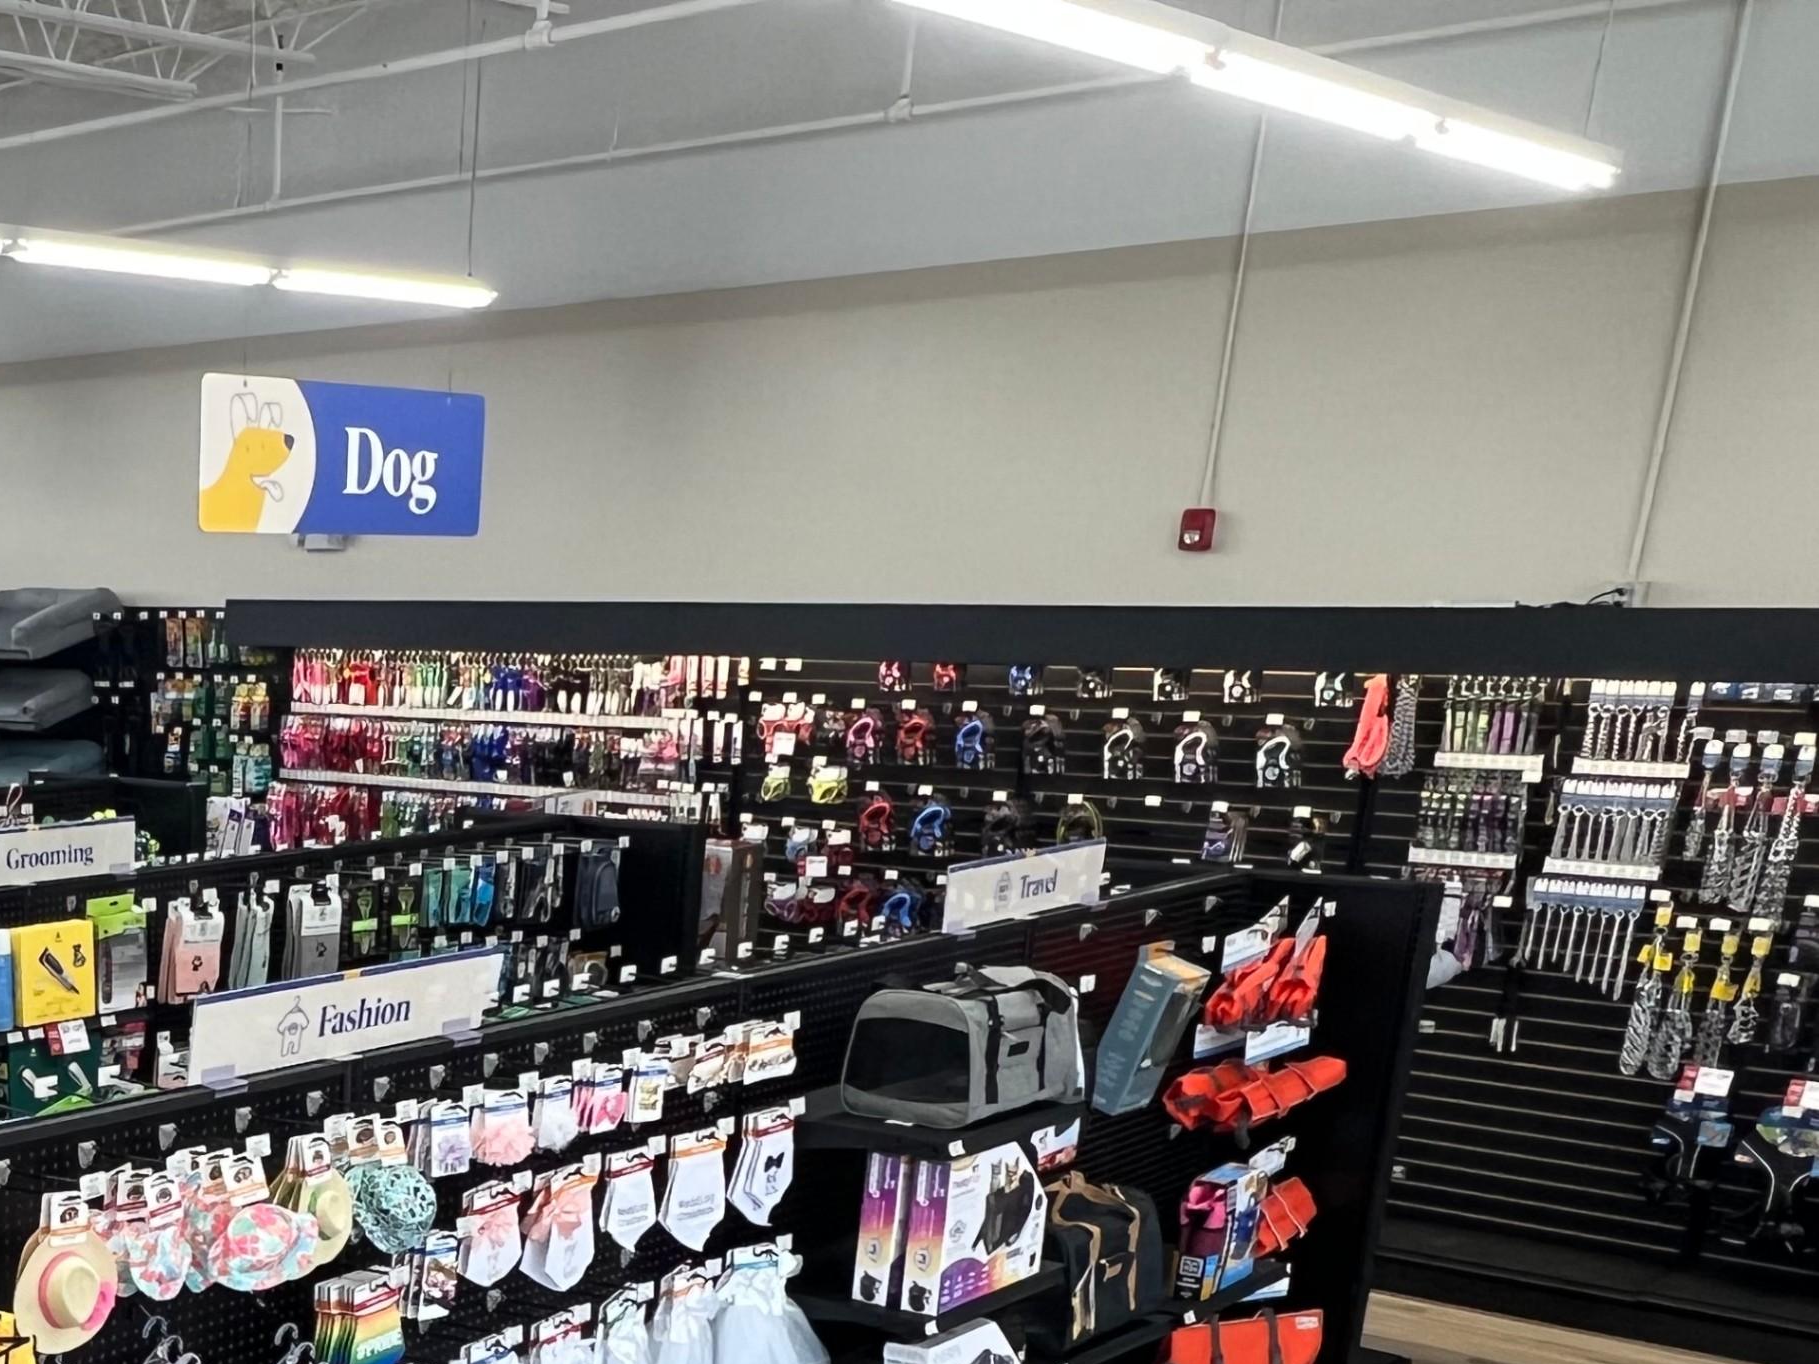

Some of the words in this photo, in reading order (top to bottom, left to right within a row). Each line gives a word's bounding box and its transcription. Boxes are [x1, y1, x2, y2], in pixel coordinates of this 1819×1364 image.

[343, 426, 438, 514] Dog
[6, 844, 94, 870] Grooming
[1020, 868, 1059, 899] Travel
[318, 999, 411, 1038] Fashion
